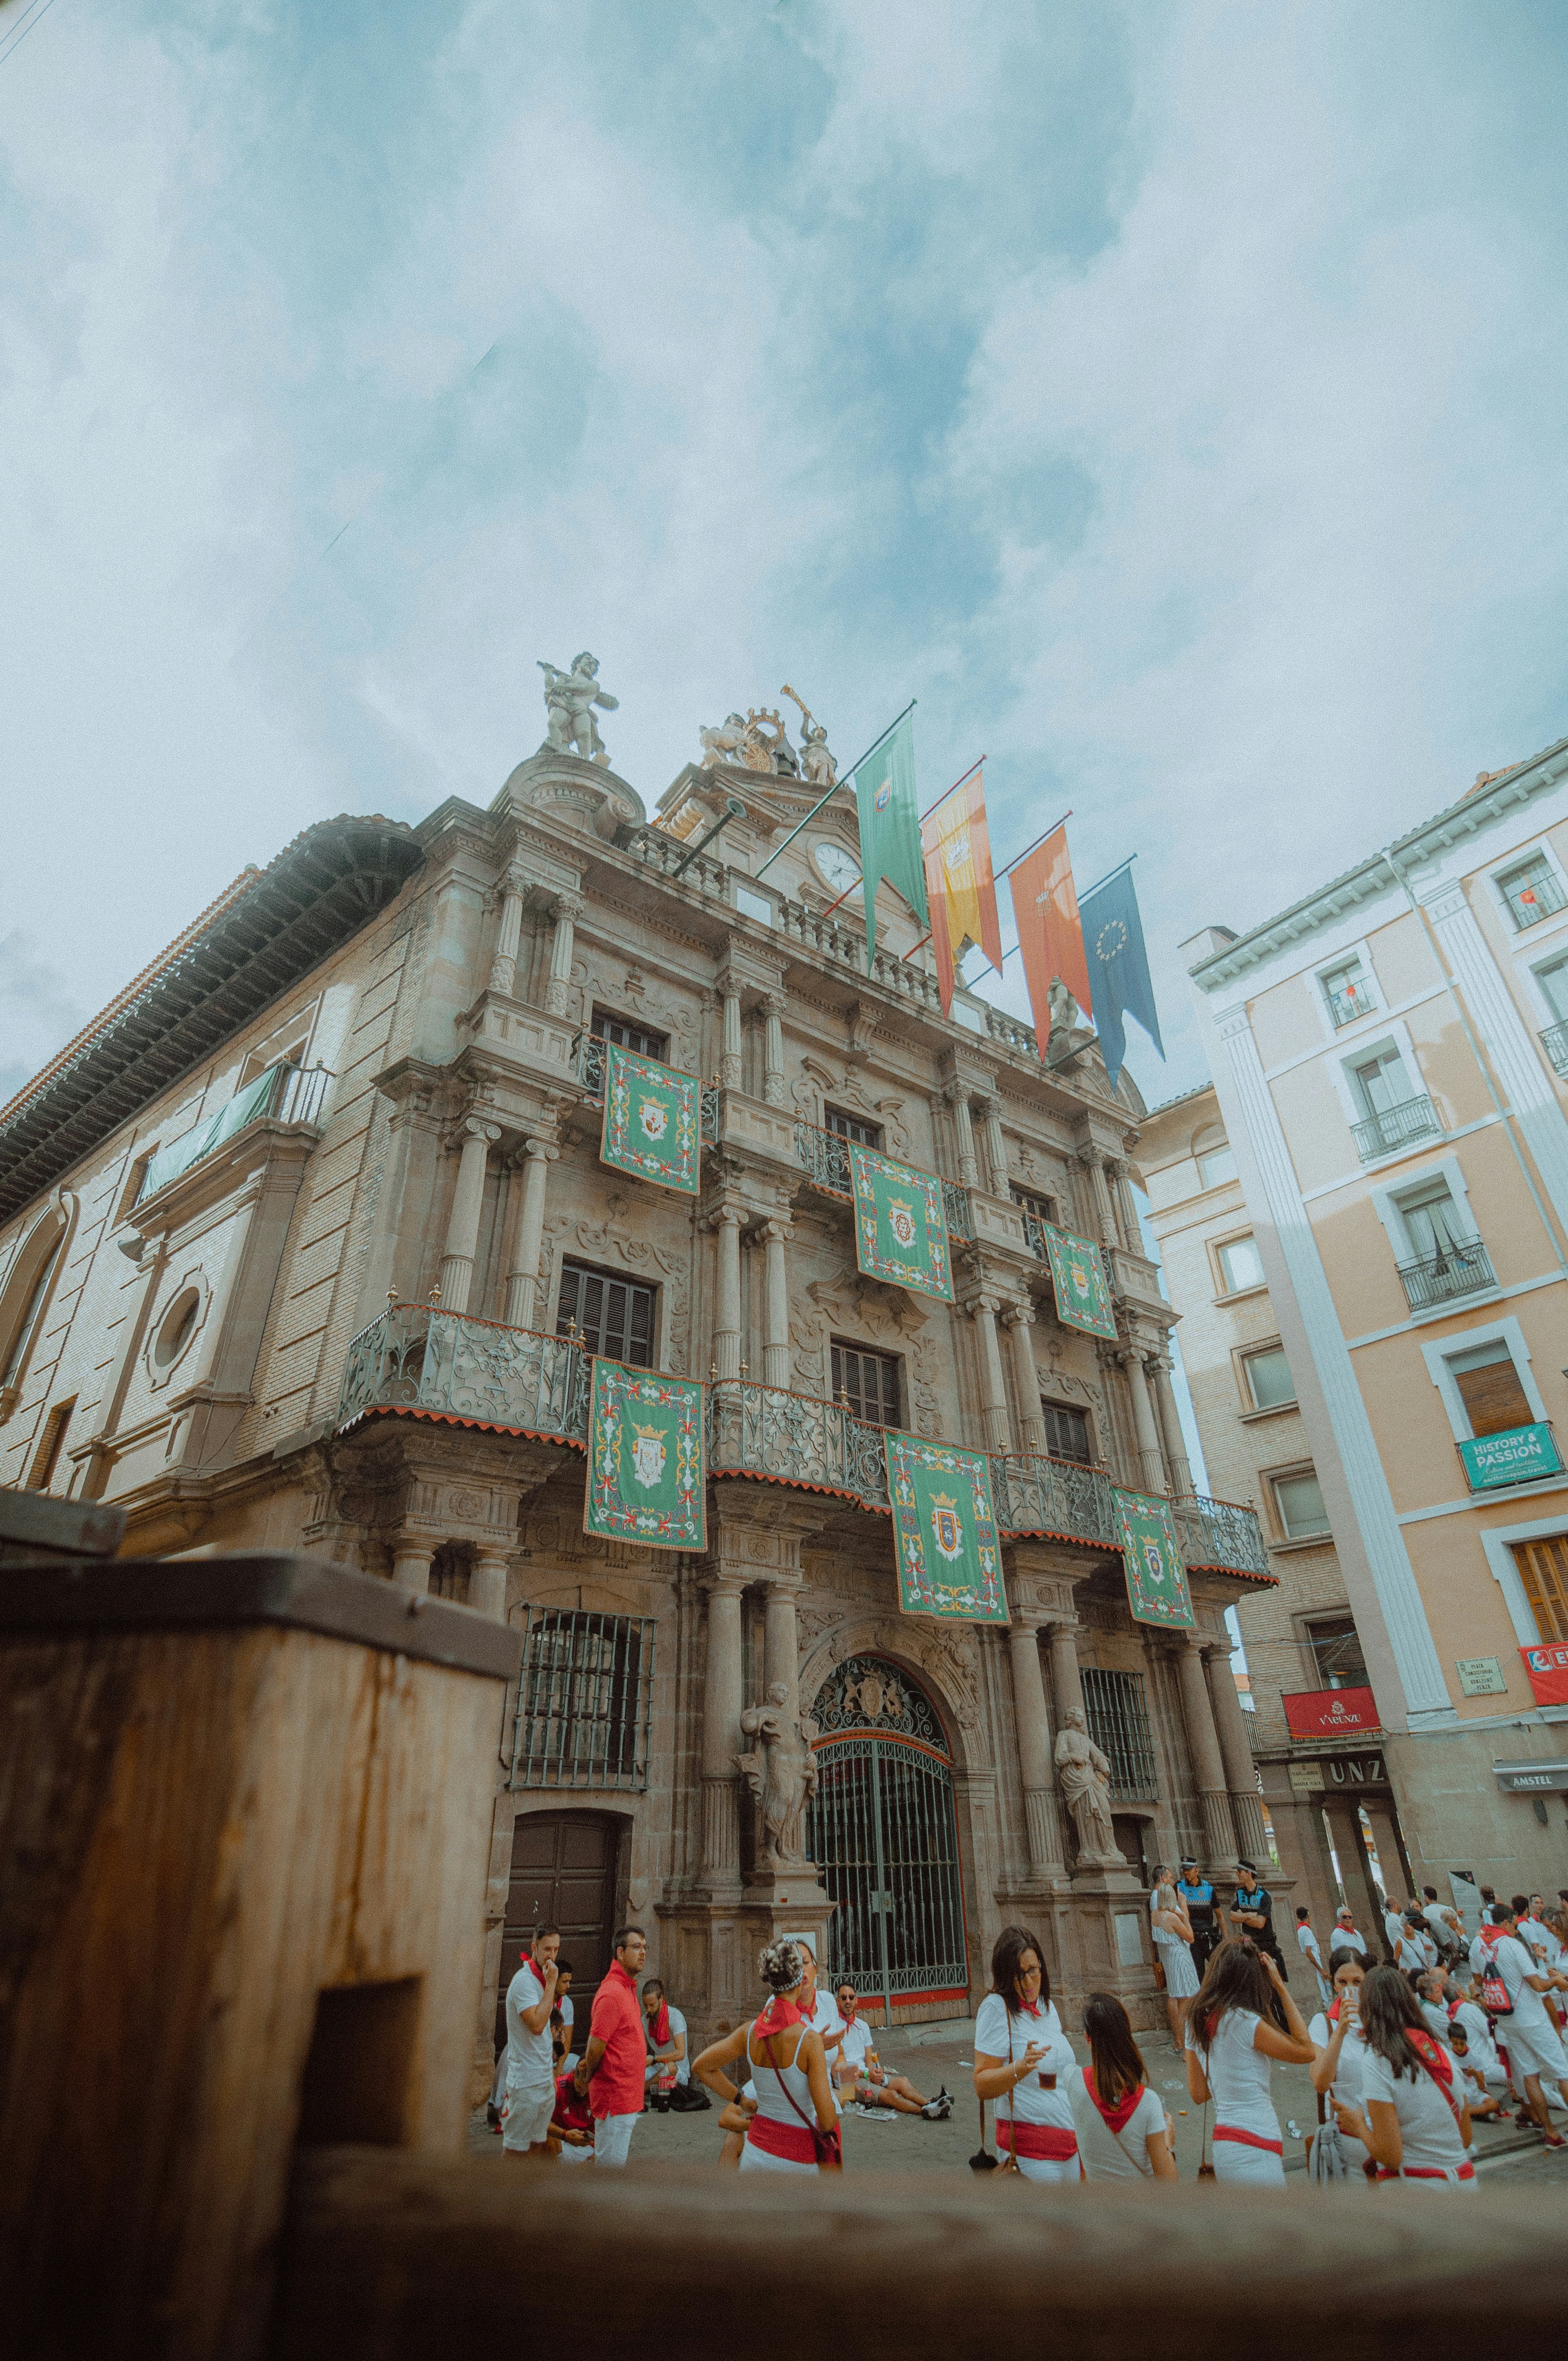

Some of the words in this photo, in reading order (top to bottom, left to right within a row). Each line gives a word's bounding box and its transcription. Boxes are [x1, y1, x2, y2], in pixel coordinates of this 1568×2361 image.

[1473, 1435, 1524, 1455] HISTORY
[1528, 1433, 1537, 1442] &
[1476, 1443, 1542, 1467] PASSION
[1483, 1465, 1547, 1483] northernspain.travel
[1555, 1651, 1568, 1664] E
[1513, 1776, 1552, 1786] AMSTEL
